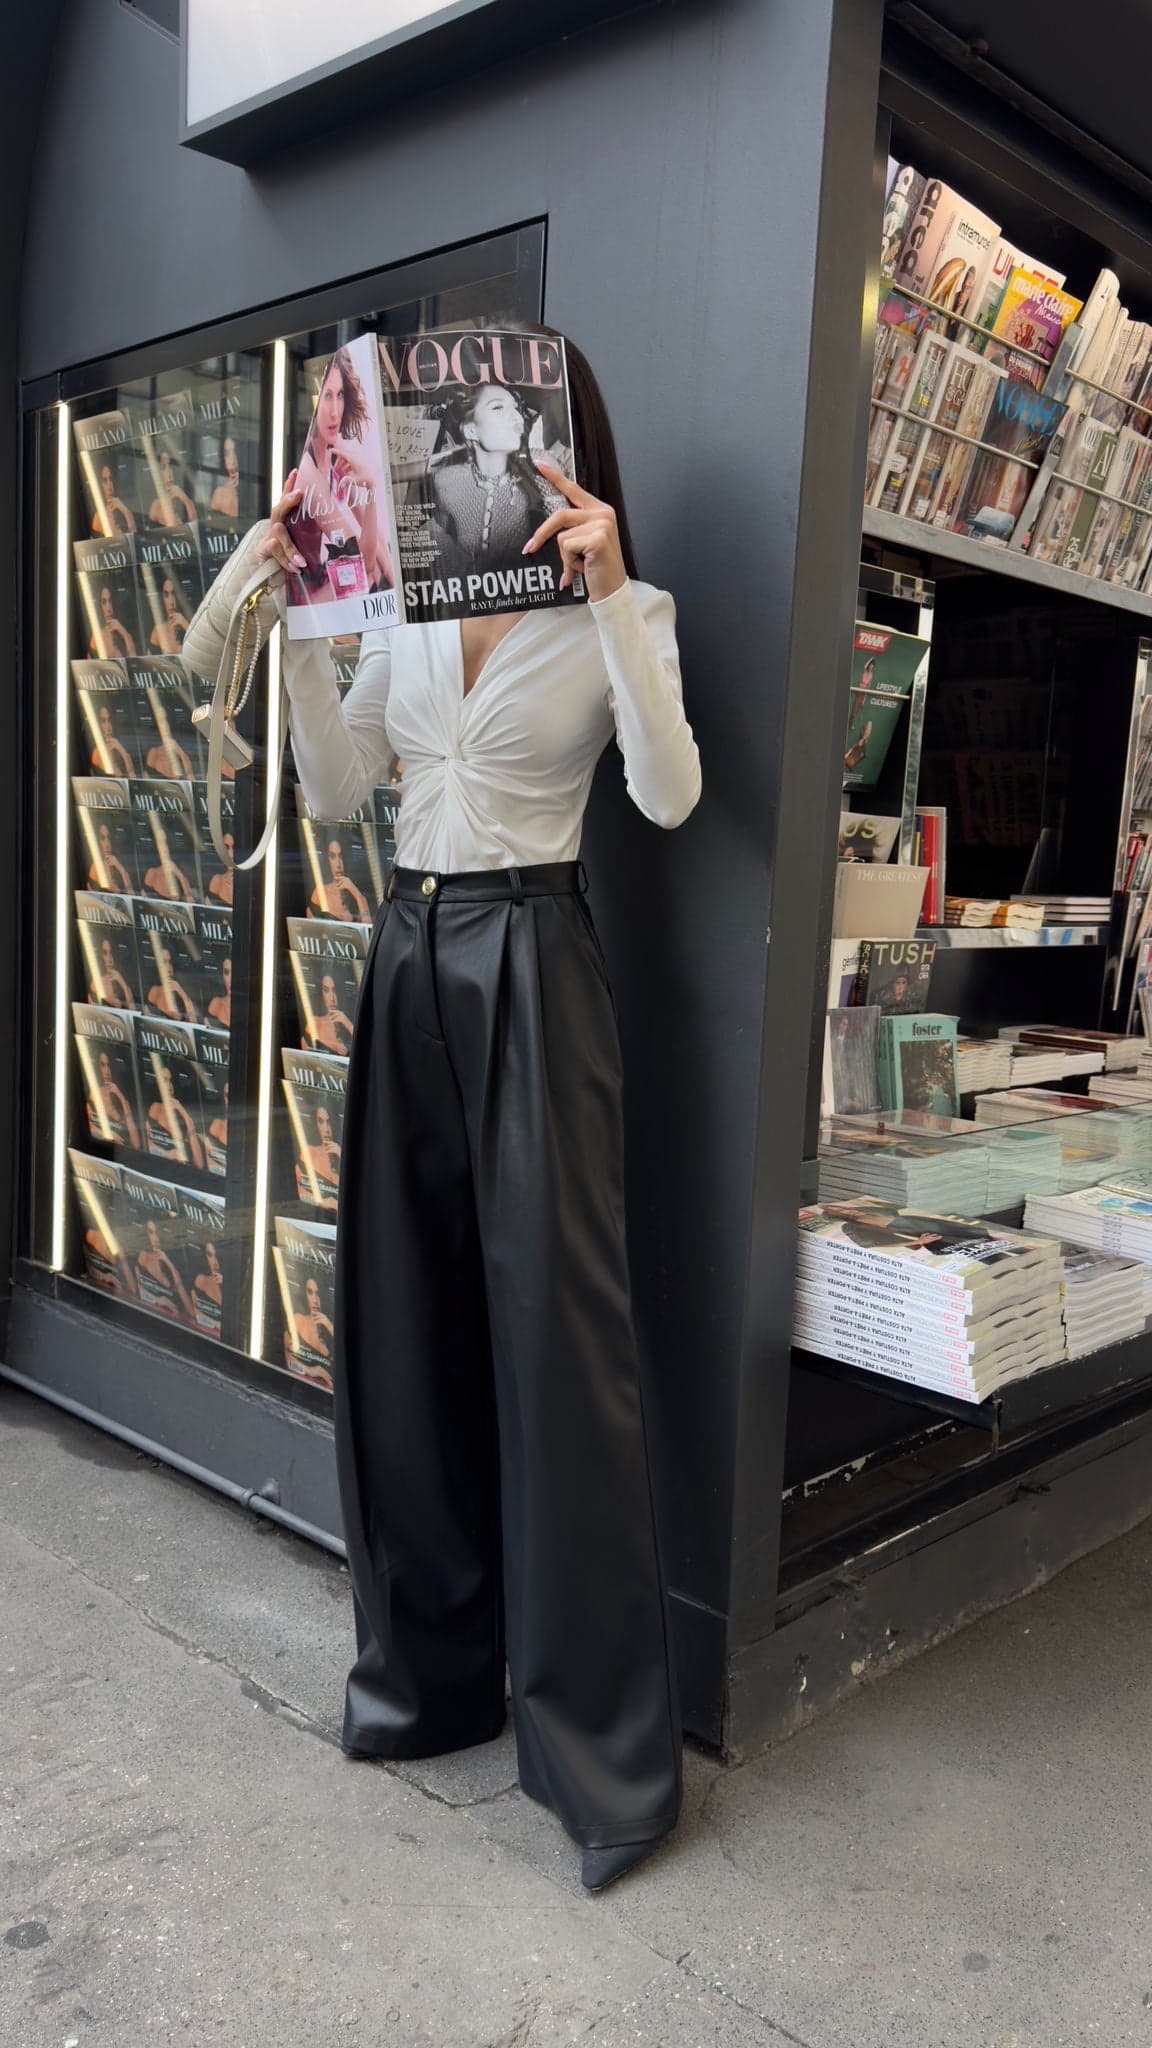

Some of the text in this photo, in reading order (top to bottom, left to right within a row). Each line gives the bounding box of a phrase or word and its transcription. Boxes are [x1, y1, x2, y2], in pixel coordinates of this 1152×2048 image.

[378, 336, 563, 394] VOGUE
[138, 408, 188, 436] MILANO
[396, 425, 425, 438] LOVE
[290, 483, 336, 524] Miss
[338, 475, 377, 509] Dior
[141, 540, 192, 563] MILANO
[80, 551, 127, 572] MILANO
[404, 565, 556, 607] STAR POWER
[363, 594, 397, 619] DIOR
[79, 673, 123, 689] MILANO
[133, 671, 183, 689] MILANO
[80, 791, 124, 809] MILANO
[135, 794, 184, 813] MILANO
[856, 869, 875, 881] THE
[139, 913, 189, 935] MILANO
[295, 935, 358, 960] MILANO
[874, 943, 937, 966] TUSH
[911, 1021, 943, 1036] foster
[140, 1031, 189, 1057] MILANO
[126, 1182, 172, 1210] MILANO
[868, 1252, 889, 1265] COSTURA
[891, 1259, 902, 1268] ALTA
[875, 1266, 897, 1279] COSTURA
[899, 1273, 910, 1282] ALTA
[875, 1278, 897, 1291] COSTURA
[899, 1286, 910, 1295] ALTA
[869, 1289, 890, 1301] COSTURA
[892, 1296, 903, 1305] ALTA
[870, 1302, 891, 1314] COSTURA
[894, 1309, 904, 1318] ALTA
[876, 1317, 899, 1329] COSTURA
[900, 1324, 912, 1333] ALTA
[871, 1327, 893, 1339] COSTURA
[895, 1334, 906, 1343] ALTA
[875, 1339, 897, 1351] COSTURA
[899, 1347, 910, 1355] ALTA
[877, 1352, 899, 1364] COSTURA
[901, 1359, 912, 1368] ALTA
[880, 1366, 902, 1378] COSTURA
[904, 1373, 915, 1381] ALTA
